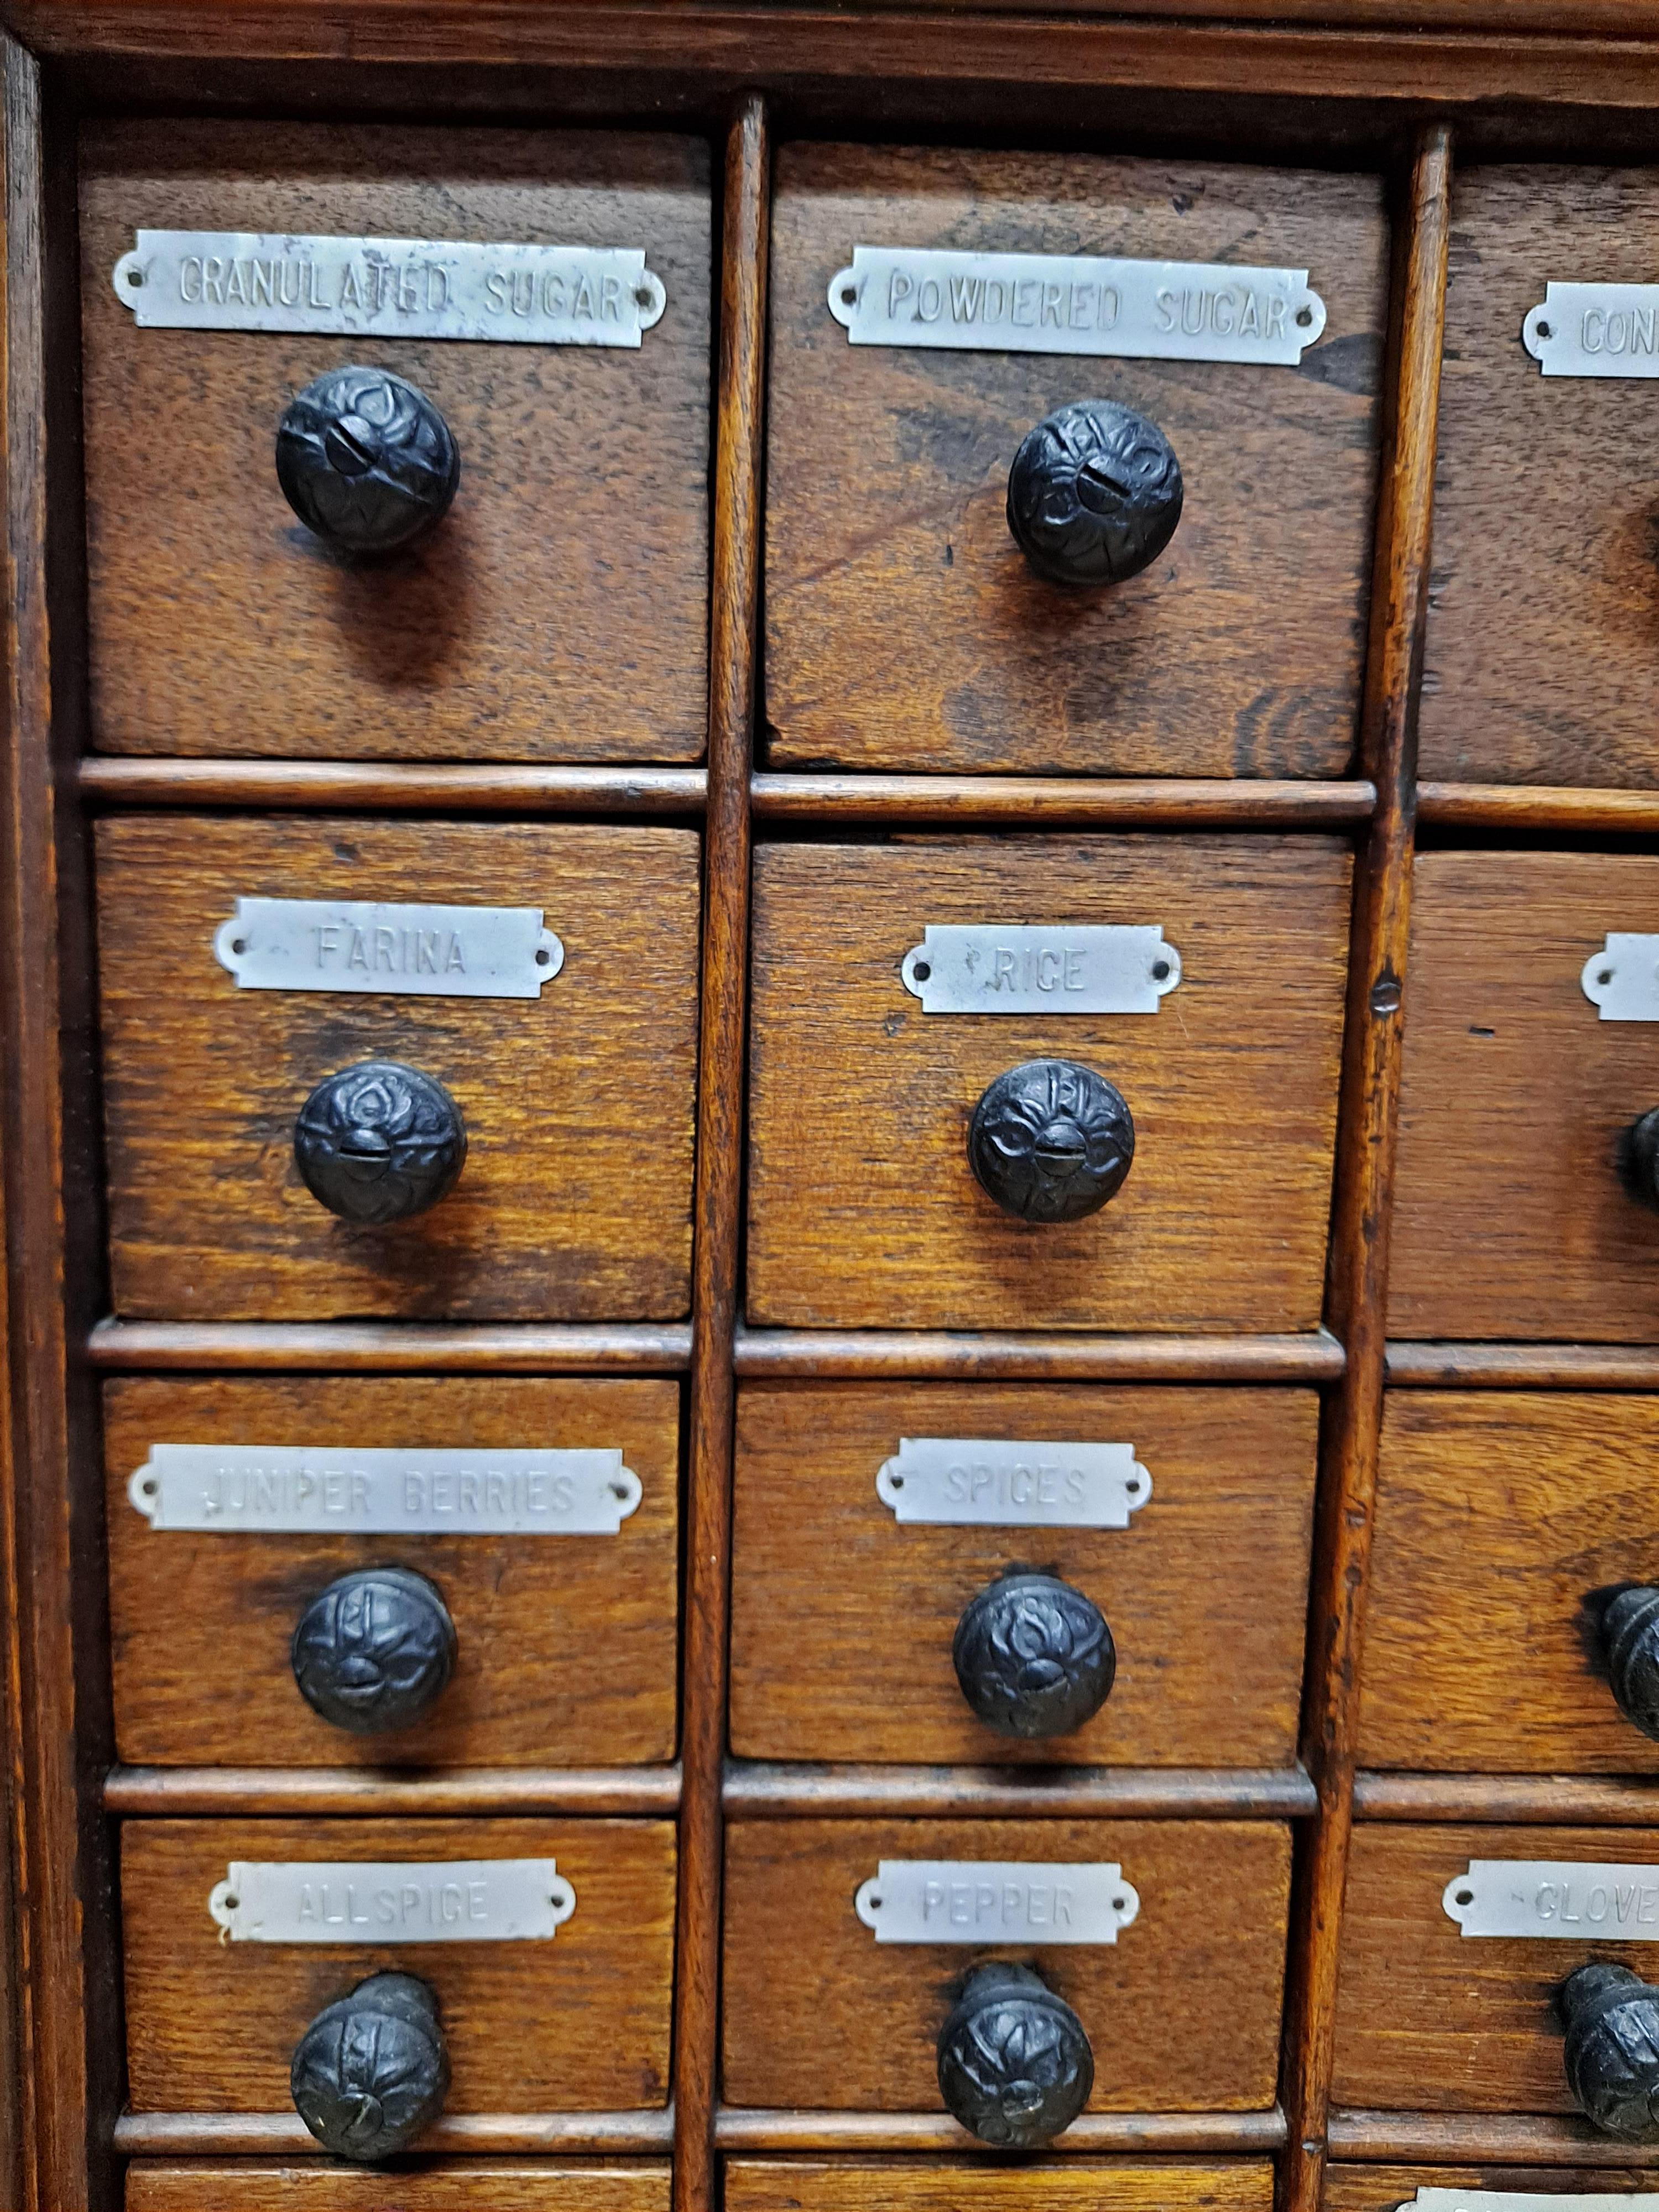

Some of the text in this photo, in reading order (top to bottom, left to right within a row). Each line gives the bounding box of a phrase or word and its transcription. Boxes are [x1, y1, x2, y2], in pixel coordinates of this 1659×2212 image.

[180, 255, 622, 321] GRANULATED SUGAR
[886, 268, 1288, 340] POWDERED SUGAR
[1581, 306, 1659, 354] CON
[315, 925, 466, 974] FARINA
[994, 947, 1087, 992] RICE
[202, 1467, 576, 1517] JUNIPER BERRIES
[943, 1463, 1085, 1504] SPICES
[298, 1881, 489, 1925] ALLSPICE
[923, 1881, 1072, 1925] PEPPER
